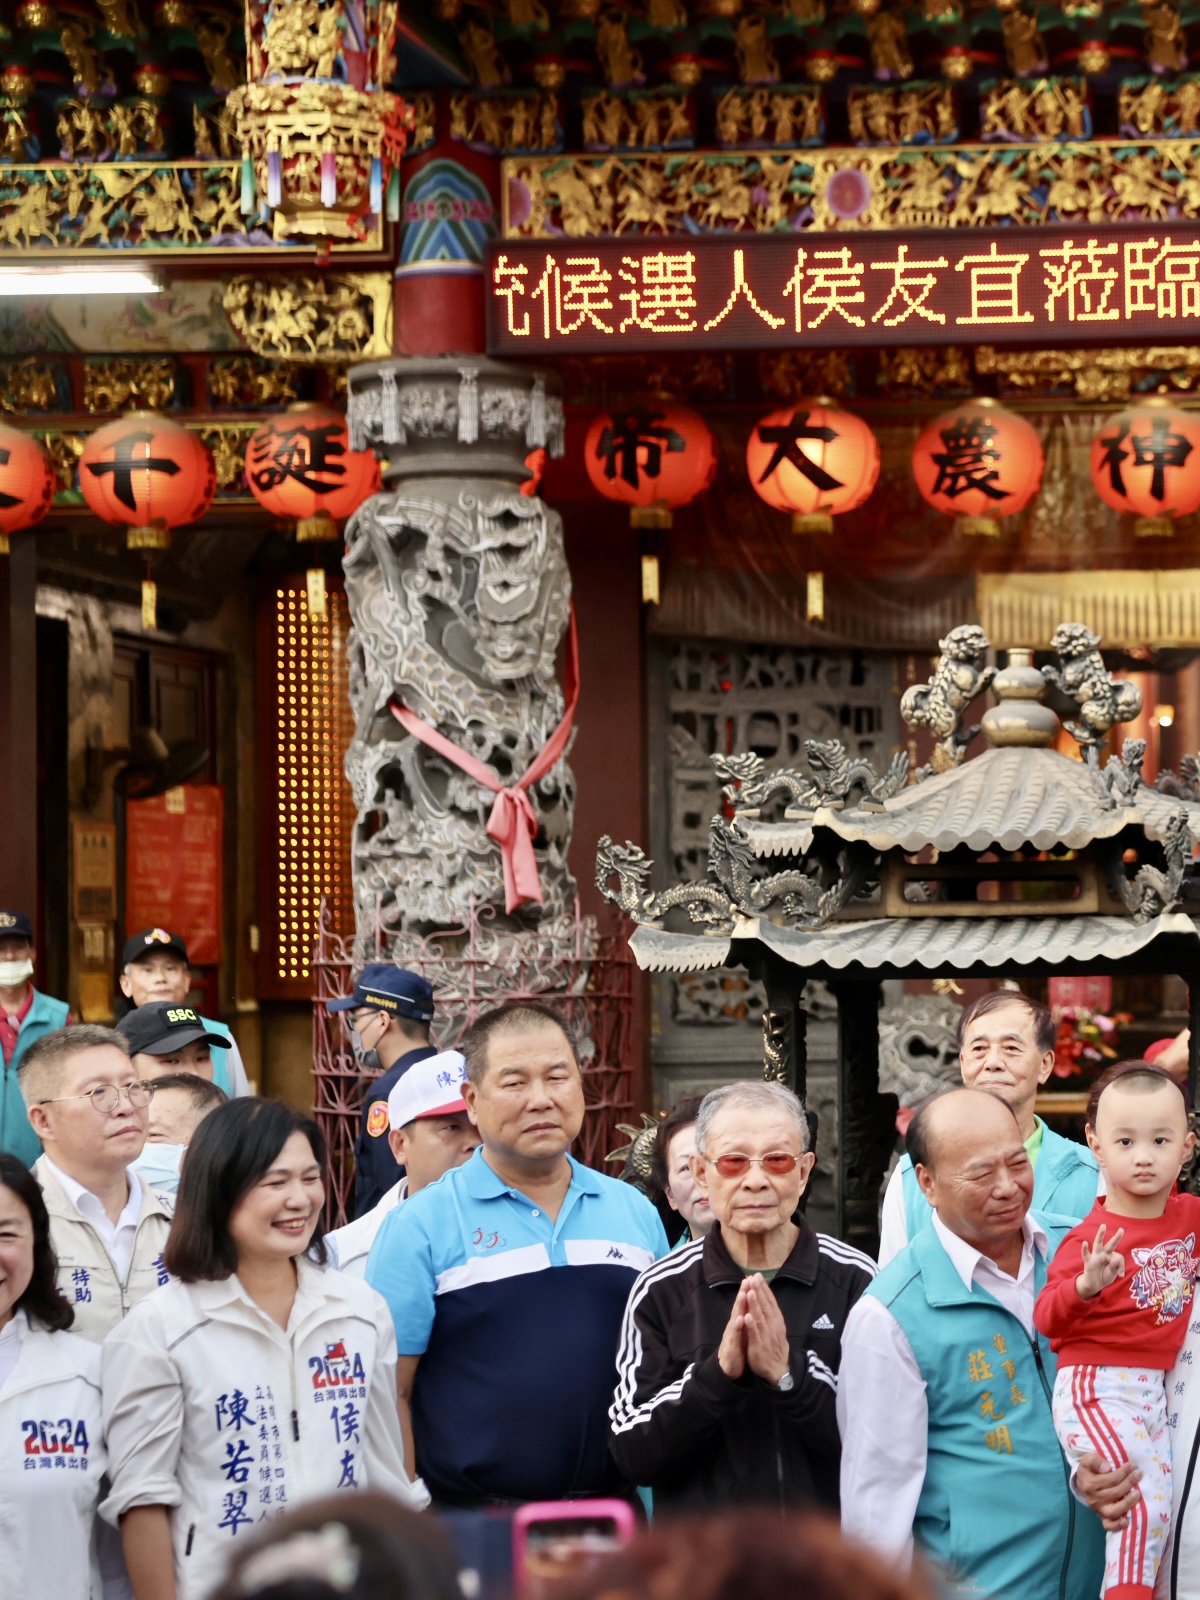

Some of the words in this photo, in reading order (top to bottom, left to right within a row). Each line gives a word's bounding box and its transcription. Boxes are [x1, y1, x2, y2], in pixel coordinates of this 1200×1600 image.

[757, 412, 845, 491] 大
[932, 415, 1012, 501] 農
[1098, 415, 1193, 501] 神
[166, 1008, 197, 1023] SSC
[308, 1352, 366, 1390] 2024
[313, 1386, 367, 1404] 台灣再出發
[968, 1349, 1013, 1454] 莊元明
[993, 1333, 1028, 1407] 董事長
[21, 1418, 90, 1455] 2024
[23, 1455, 89, 1471] 台灣再出發
[214, 1388, 257, 1536] 陳若翠
[254, 1384, 272, 1523] 立法委員候選人
[330, 1402, 361, 1489] 侯友
